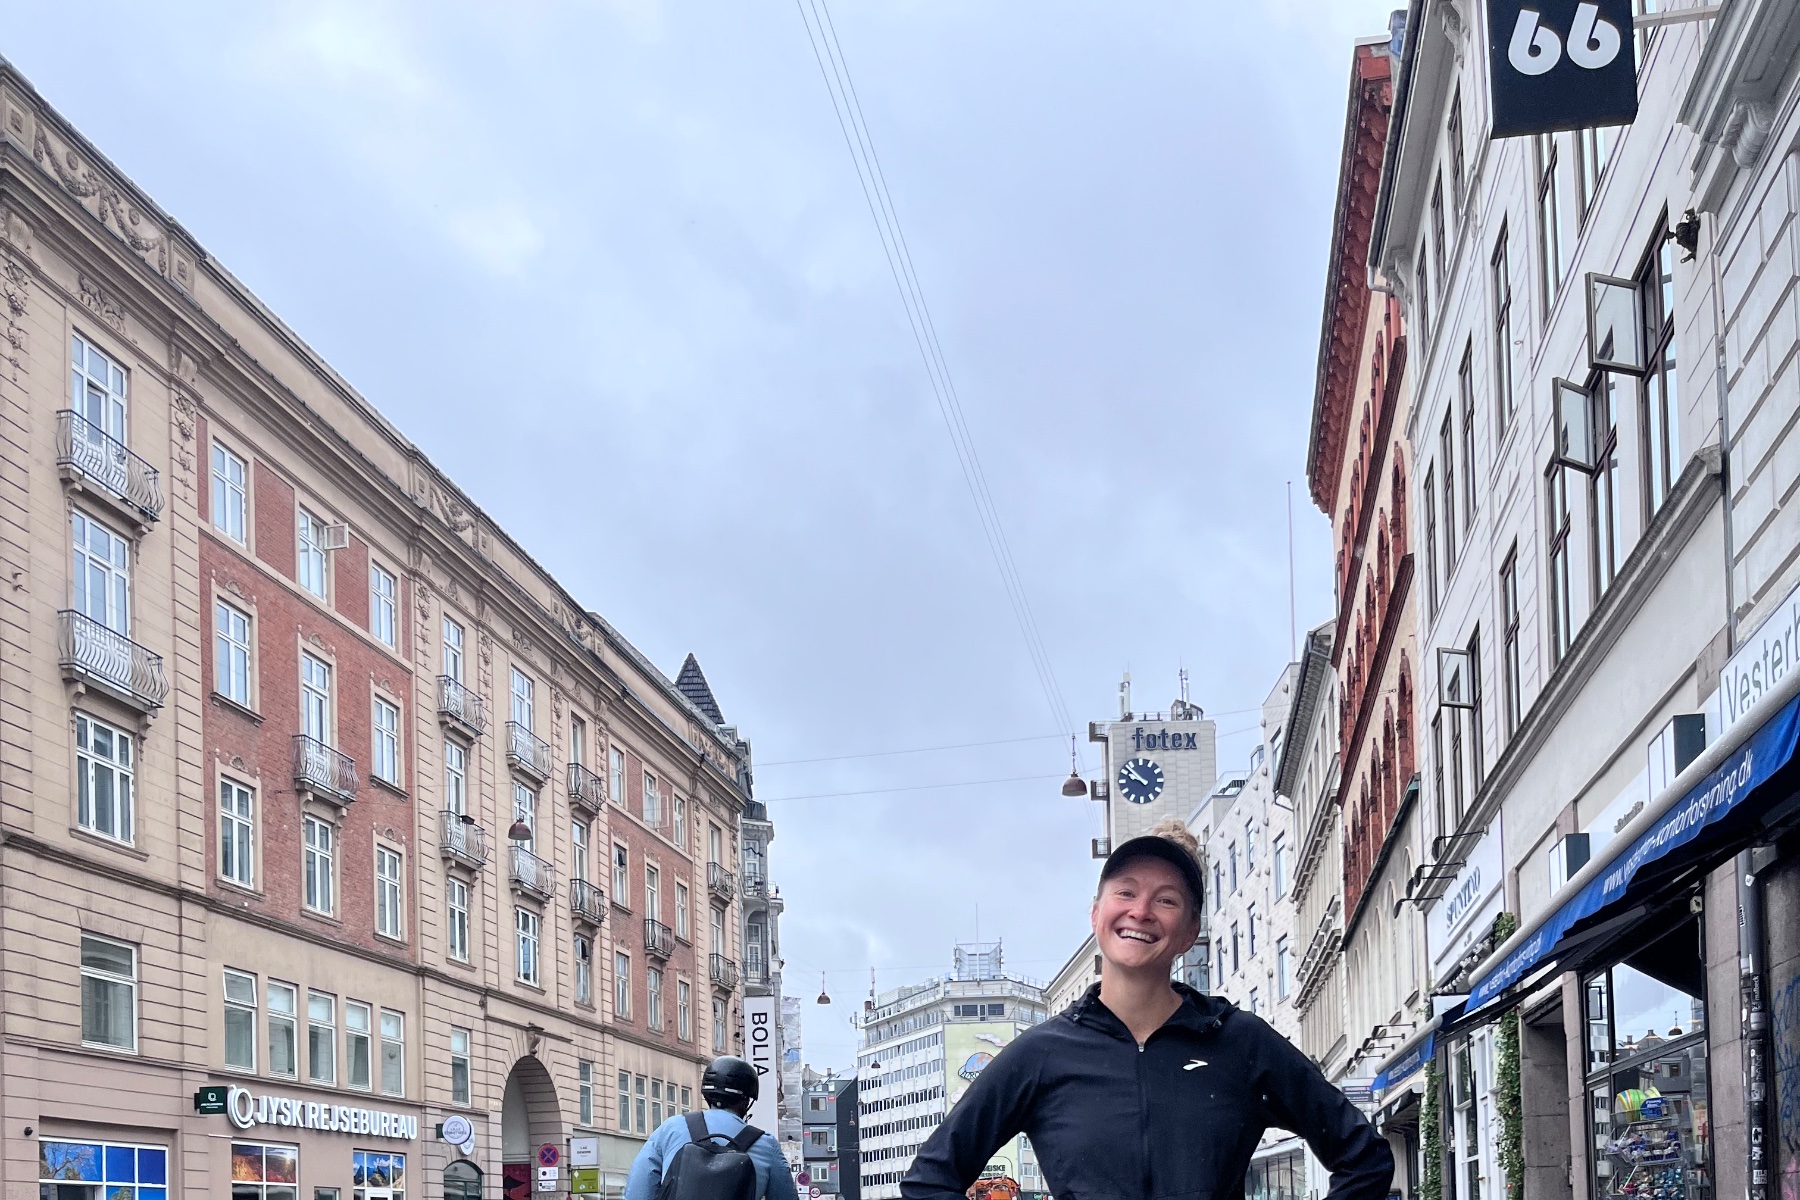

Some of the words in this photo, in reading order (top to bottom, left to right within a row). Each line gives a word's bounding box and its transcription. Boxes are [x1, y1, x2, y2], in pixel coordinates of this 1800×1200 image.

[1508, 2, 1621, 76] 66
[752, 1012, 769, 1077] BOLIA
[256, 1096, 304, 1127] JYSK
[304, 1102, 418, 1140] REJSEBUREAU
